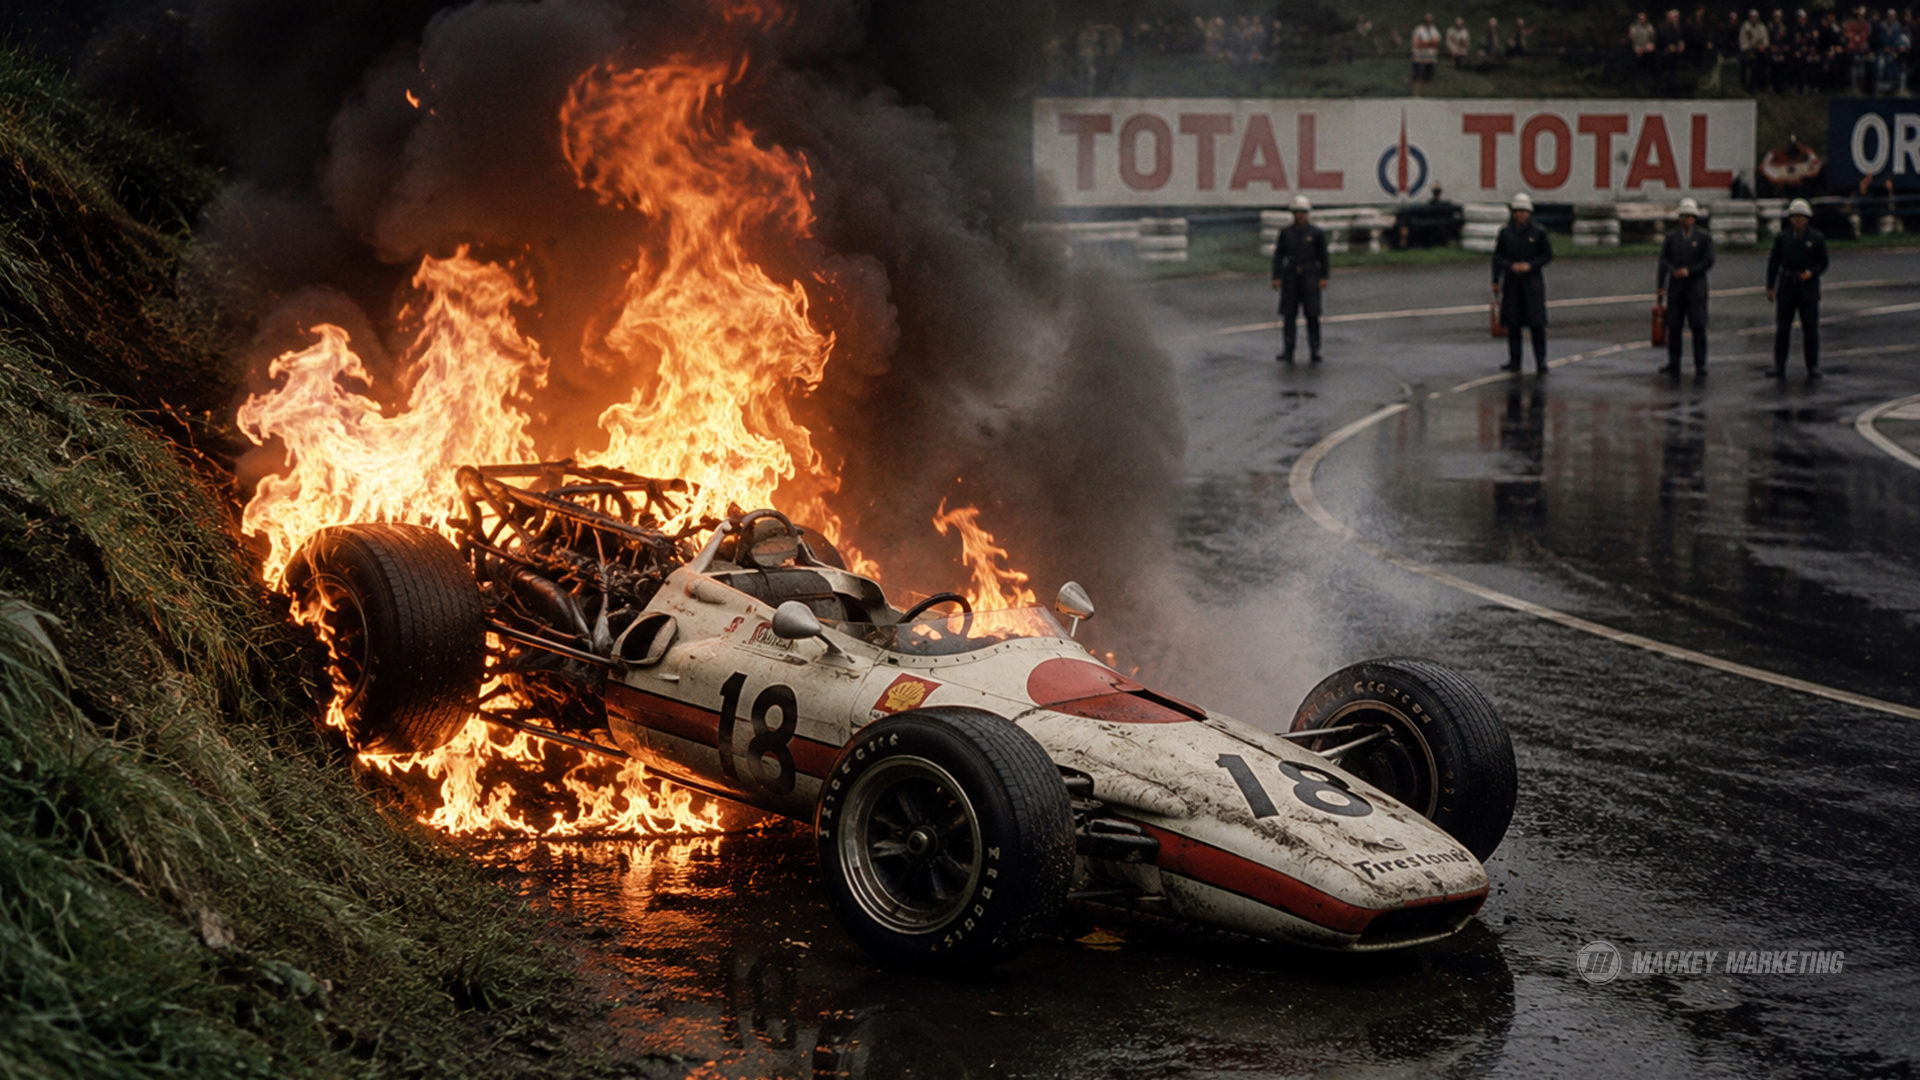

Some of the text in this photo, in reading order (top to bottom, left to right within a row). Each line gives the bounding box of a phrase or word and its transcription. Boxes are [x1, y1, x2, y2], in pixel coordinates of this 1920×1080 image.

[1058, 113, 1733, 192] TOTAL TOTAL
[719, 671, 797, 795] 18
[1215, 754, 1373, 819] 18
